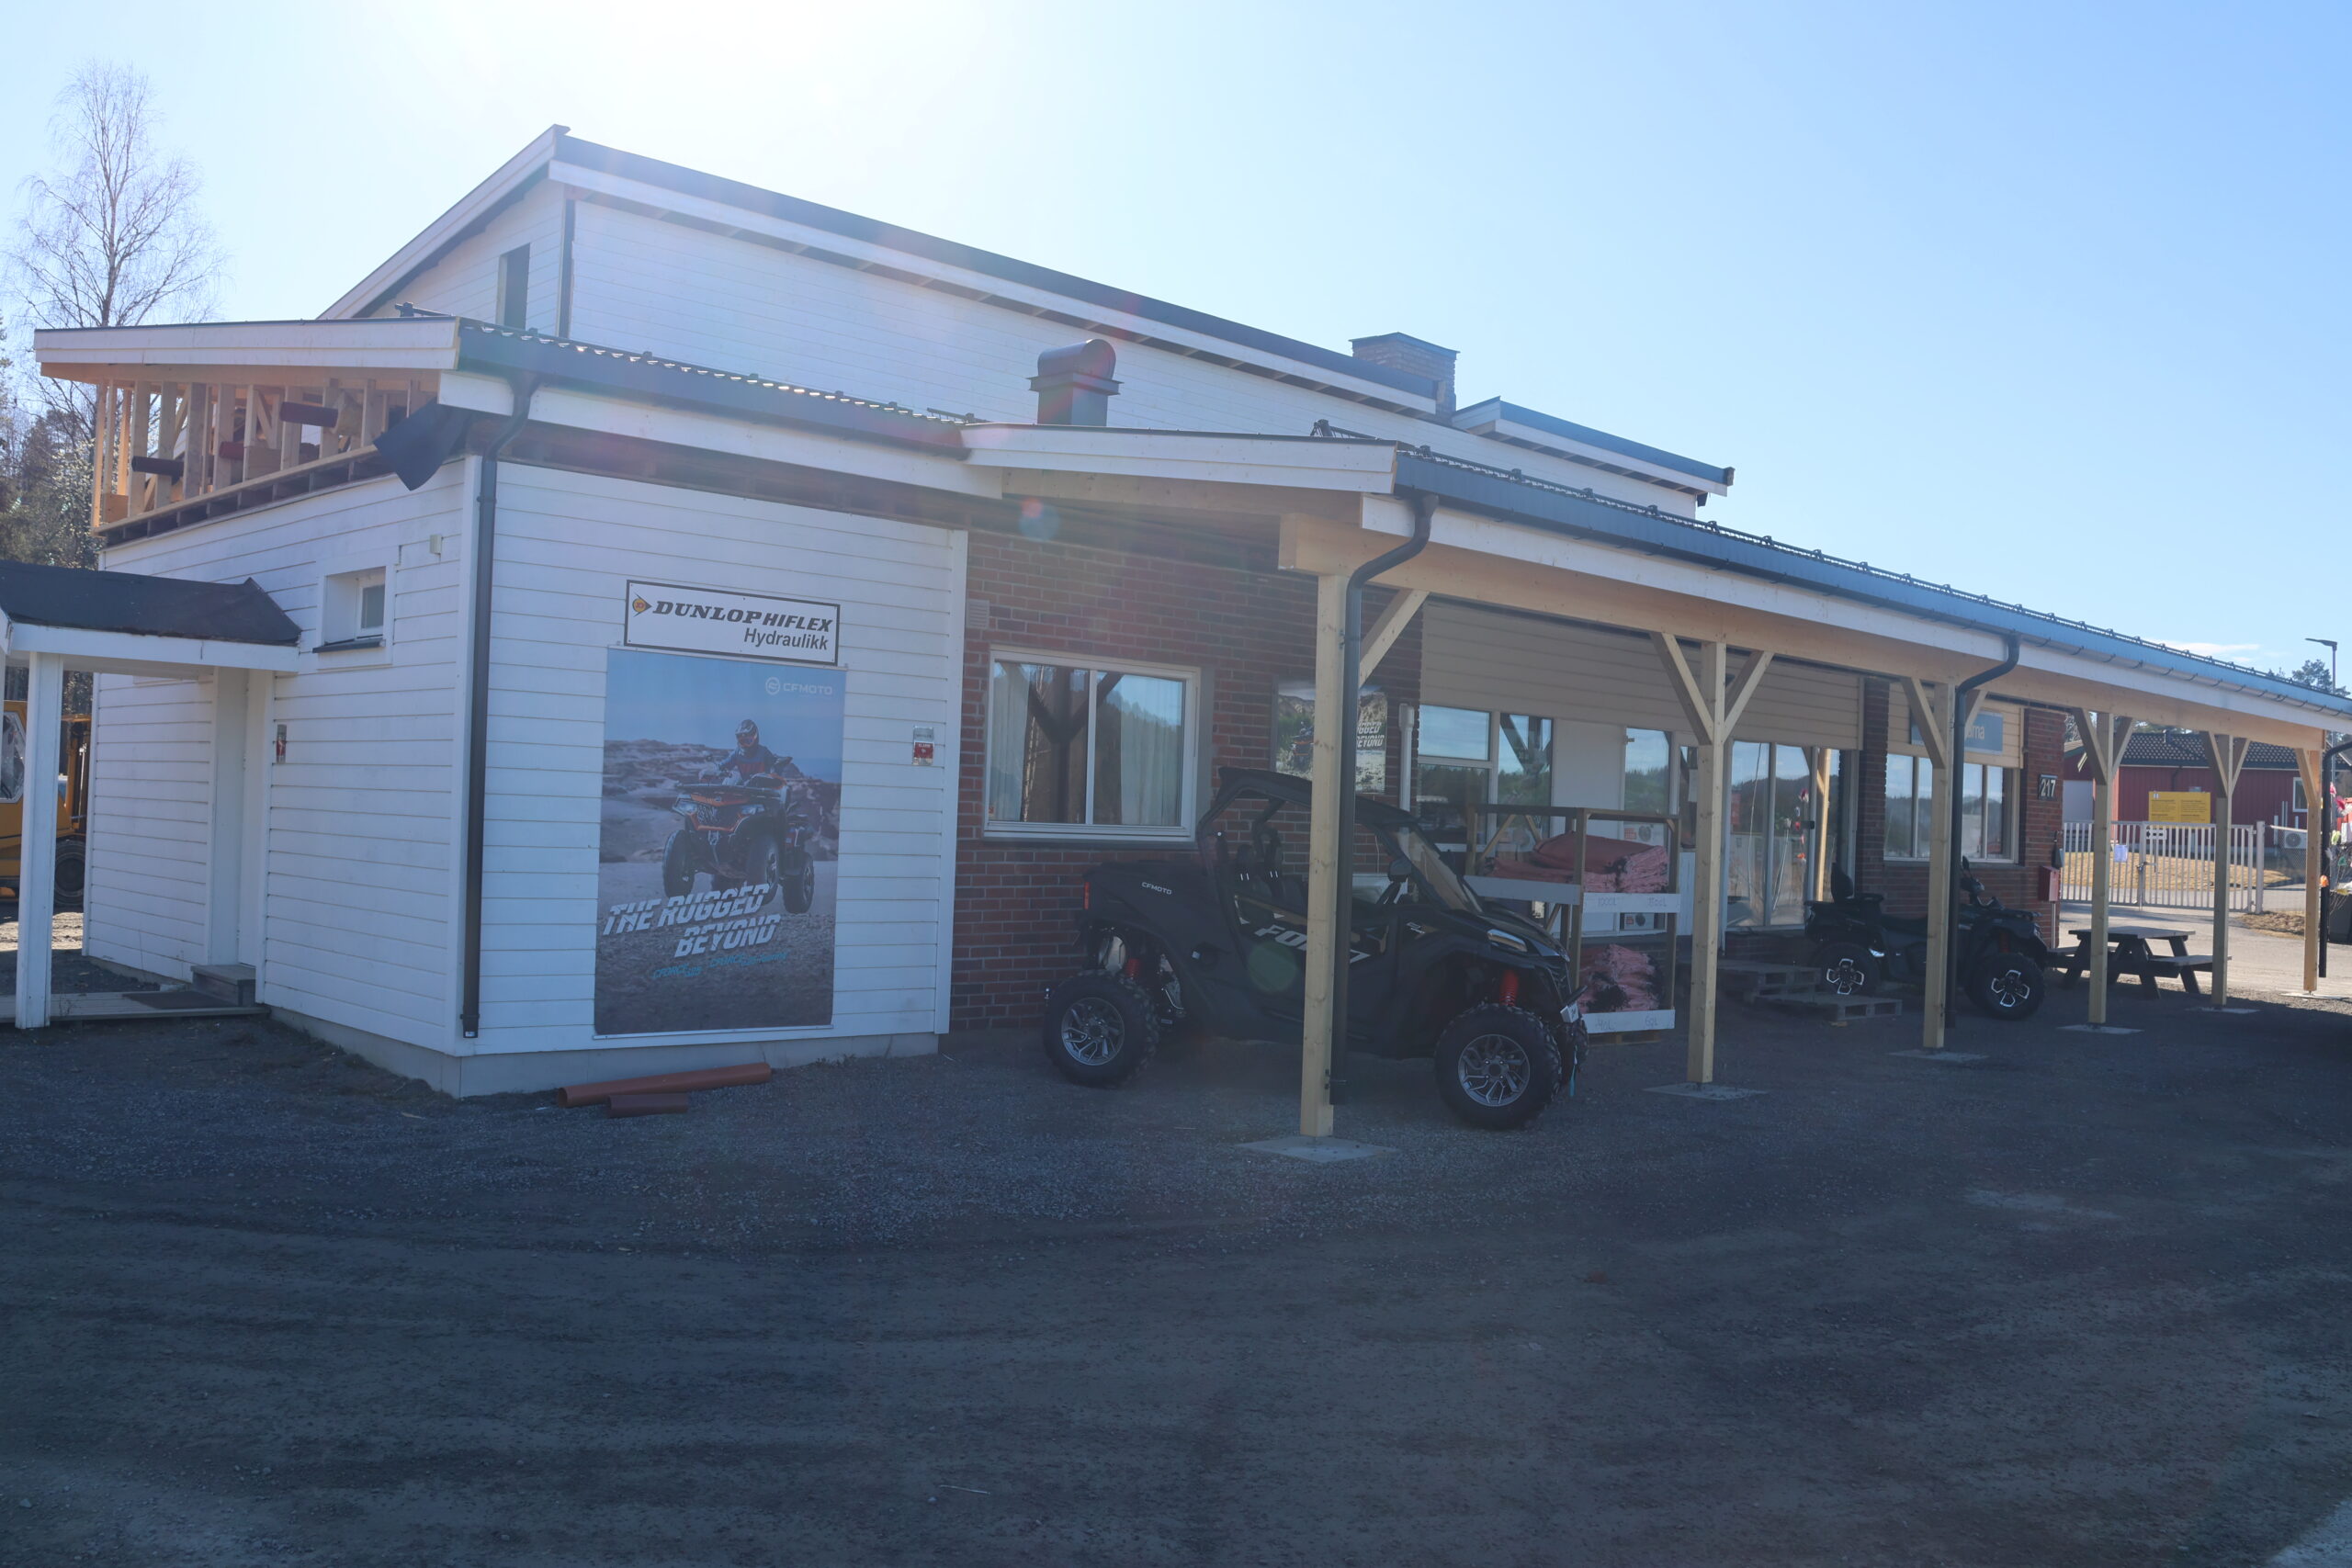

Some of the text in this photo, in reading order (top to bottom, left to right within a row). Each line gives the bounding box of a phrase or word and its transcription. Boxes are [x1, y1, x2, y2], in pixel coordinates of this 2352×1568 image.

[743, 627, 830, 650] Hydraulikk
[783, 682, 833, 695] CFMOTO
[2040, 778, 2057, 798] 217
[1141, 882, 1172, 895] CFMOTO
[602, 883, 771, 936] THE RUGGED
[673, 913, 782, 958] BEYOND
